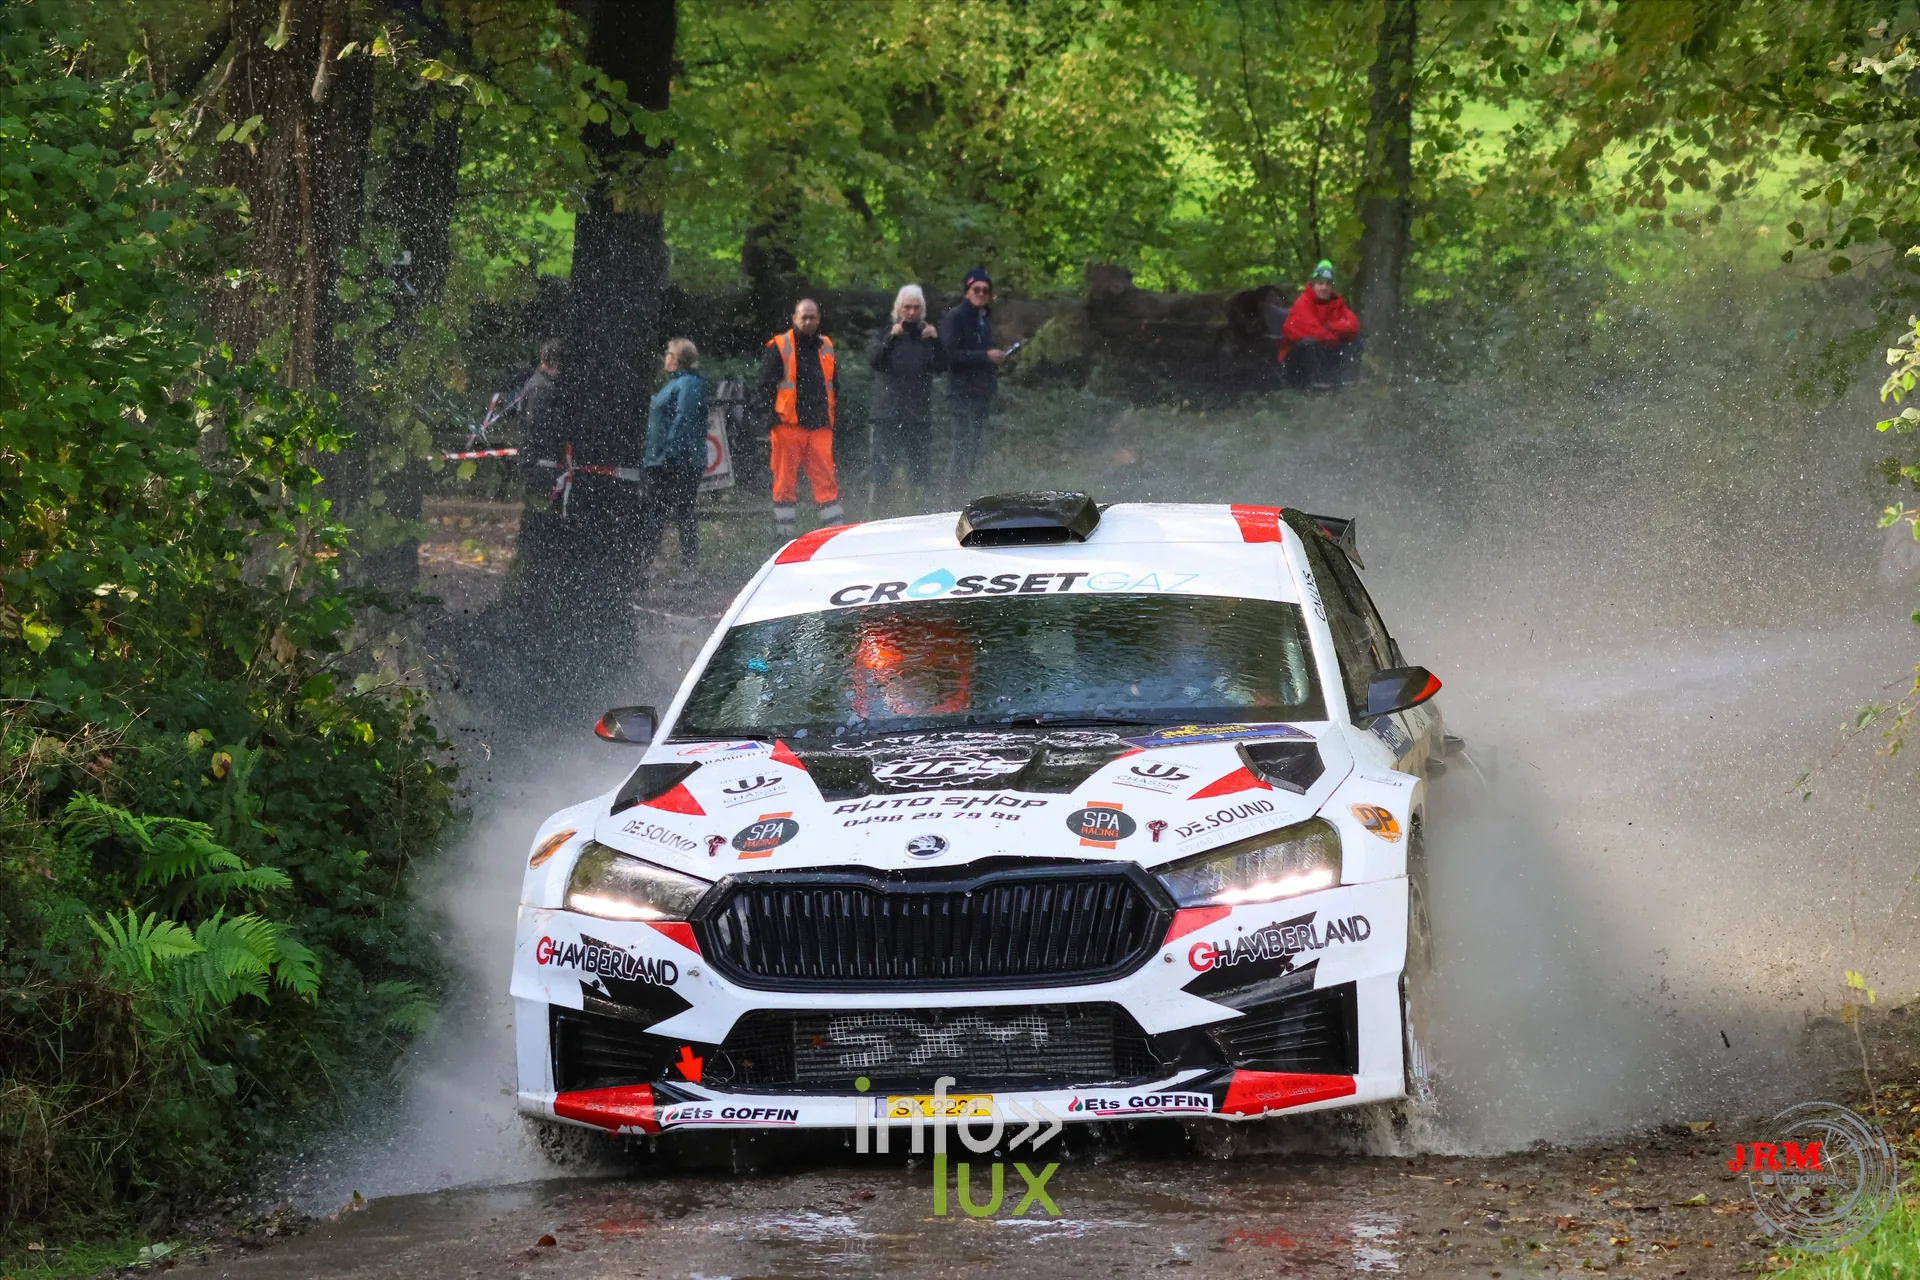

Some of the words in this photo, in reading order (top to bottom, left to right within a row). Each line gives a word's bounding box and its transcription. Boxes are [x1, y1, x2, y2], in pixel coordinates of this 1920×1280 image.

[1116, 775, 1180, 791] CHASSIS
[833, 796, 936, 815] AUTO
[941, 793, 1049, 809] SHOP
[842, 813, 905, 827] 0498
[911, 811, 943, 820] 29
[951, 811, 982, 820] 79
[989, 811, 1022, 821] 88
[1081, 811, 1121, 830] SPA
[747, 822, 785, 841] SPA
[1080, 826, 1121, 838] RACING
[743, 836, 780, 849] RACING
[895, 1099, 926, 1116] SK
[932, 1099, 979, 1115] 2231
[1084, 1097, 1121, 1111] Ets
[1128, 1094, 1210, 1108] GOFFIN
[679, 1107, 713, 1120] Ets
[720, 1107, 800, 1122] GOFFIN
